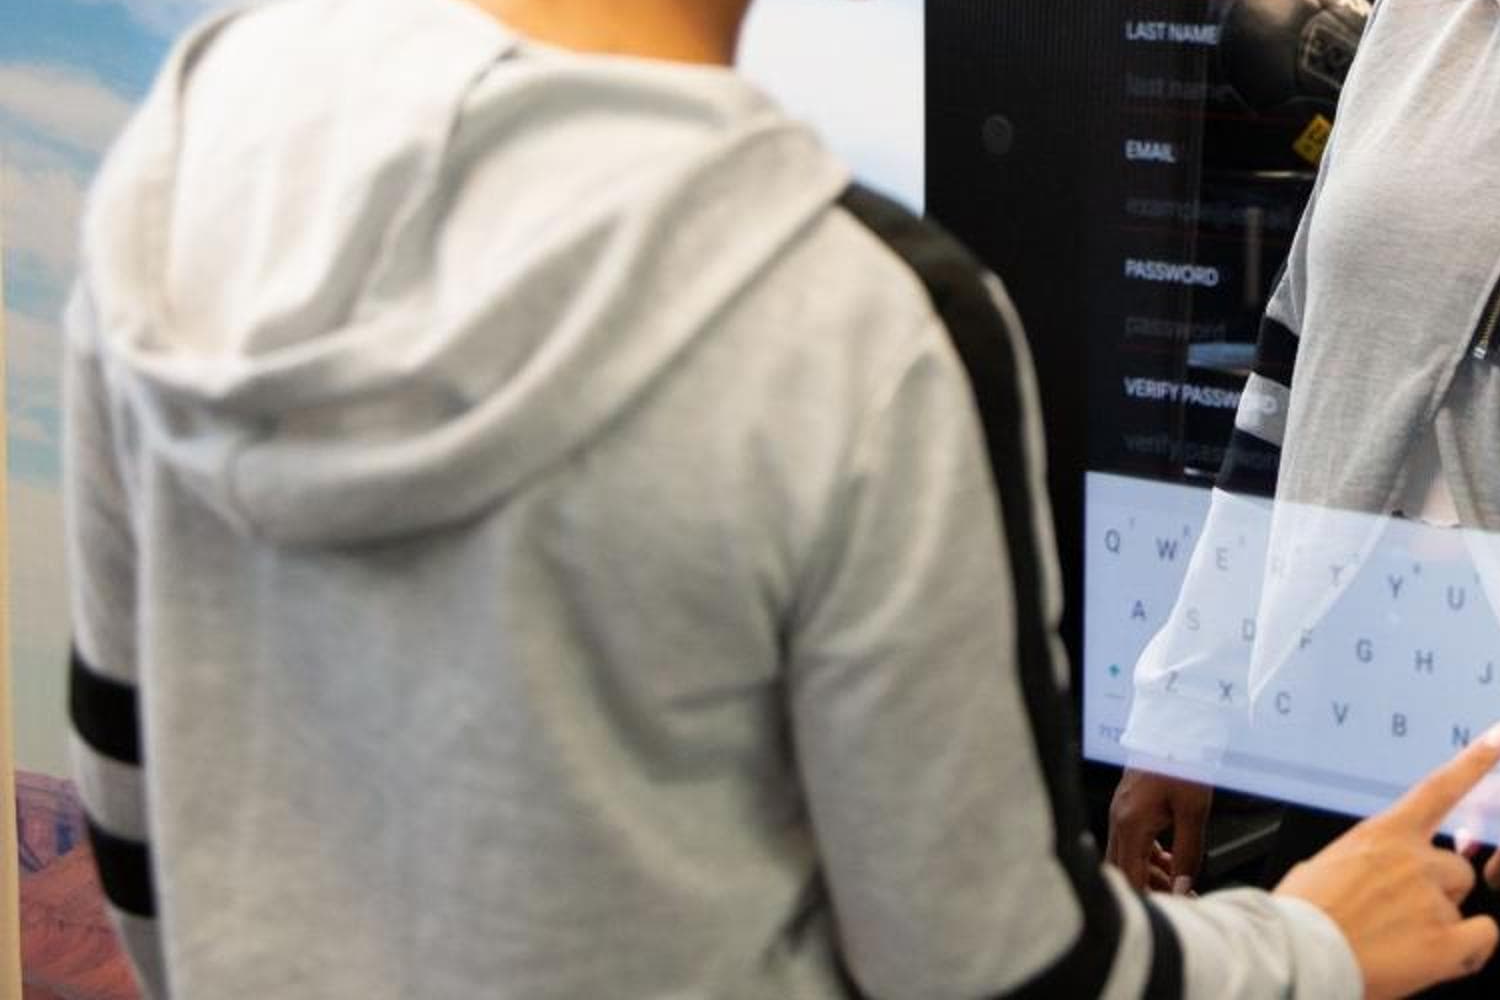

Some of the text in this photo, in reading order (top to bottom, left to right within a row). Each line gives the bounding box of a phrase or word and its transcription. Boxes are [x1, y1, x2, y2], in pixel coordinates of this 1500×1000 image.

[1126, 22, 1219, 46] LAST NAME
[1125, 138, 1176, 164] EMAIL
[1125, 258, 1219, 287] PASSWORD
[1124, 377, 1181, 402] VERIFY
[1104, 529, 1121, 553] Q
[1156, 538, 1178, 561] W
[1215, 547, 1229, 571] E
[1387, 574, 1404, 599] Y
[1446, 585, 1466, 611] U
[1131, 599, 1147, 621] A
[1185, 608, 1200, 631] S
[1241, 618, 1257, 642] D
[1354, 638, 1373, 663] G
[1414, 649, 1434, 674] H
[1477, 661, 1493, 685] J
[1218, 679, 1233, 703] X
[1275, 690, 1291, 716] C
[1331, 700, 1349, 727] V
[1390, 712, 1408, 739] B
[1452, 724, 1470, 749] N
